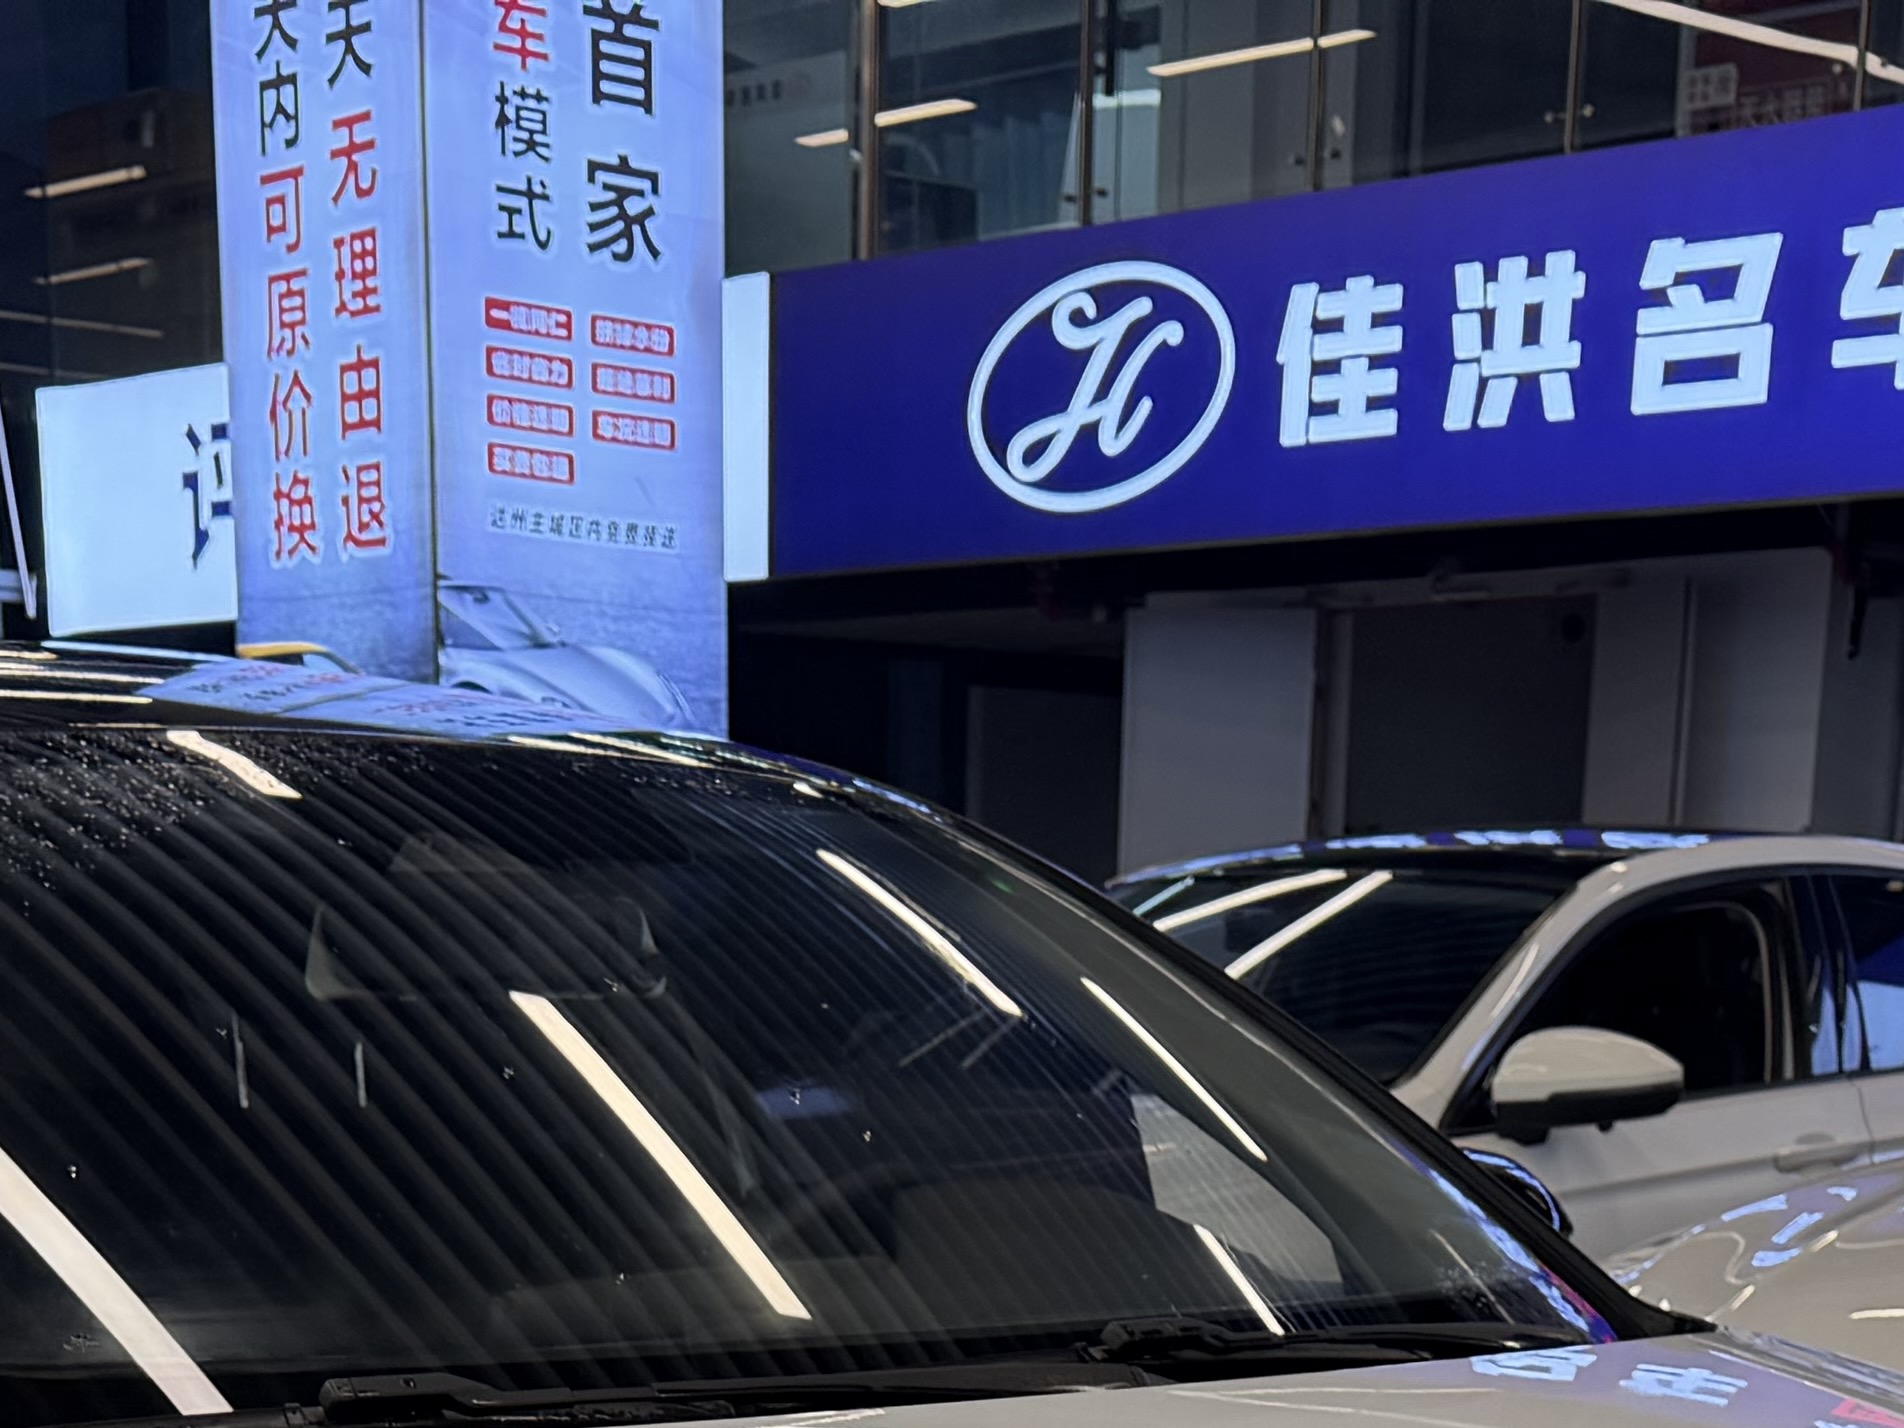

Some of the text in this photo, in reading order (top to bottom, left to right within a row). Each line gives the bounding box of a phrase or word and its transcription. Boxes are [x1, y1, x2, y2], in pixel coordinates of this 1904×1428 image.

[493, 0, 553, 251] 车模式
[582, 0, 662, 264] 首家
[326, 0, 387, 551] 天无理由退
